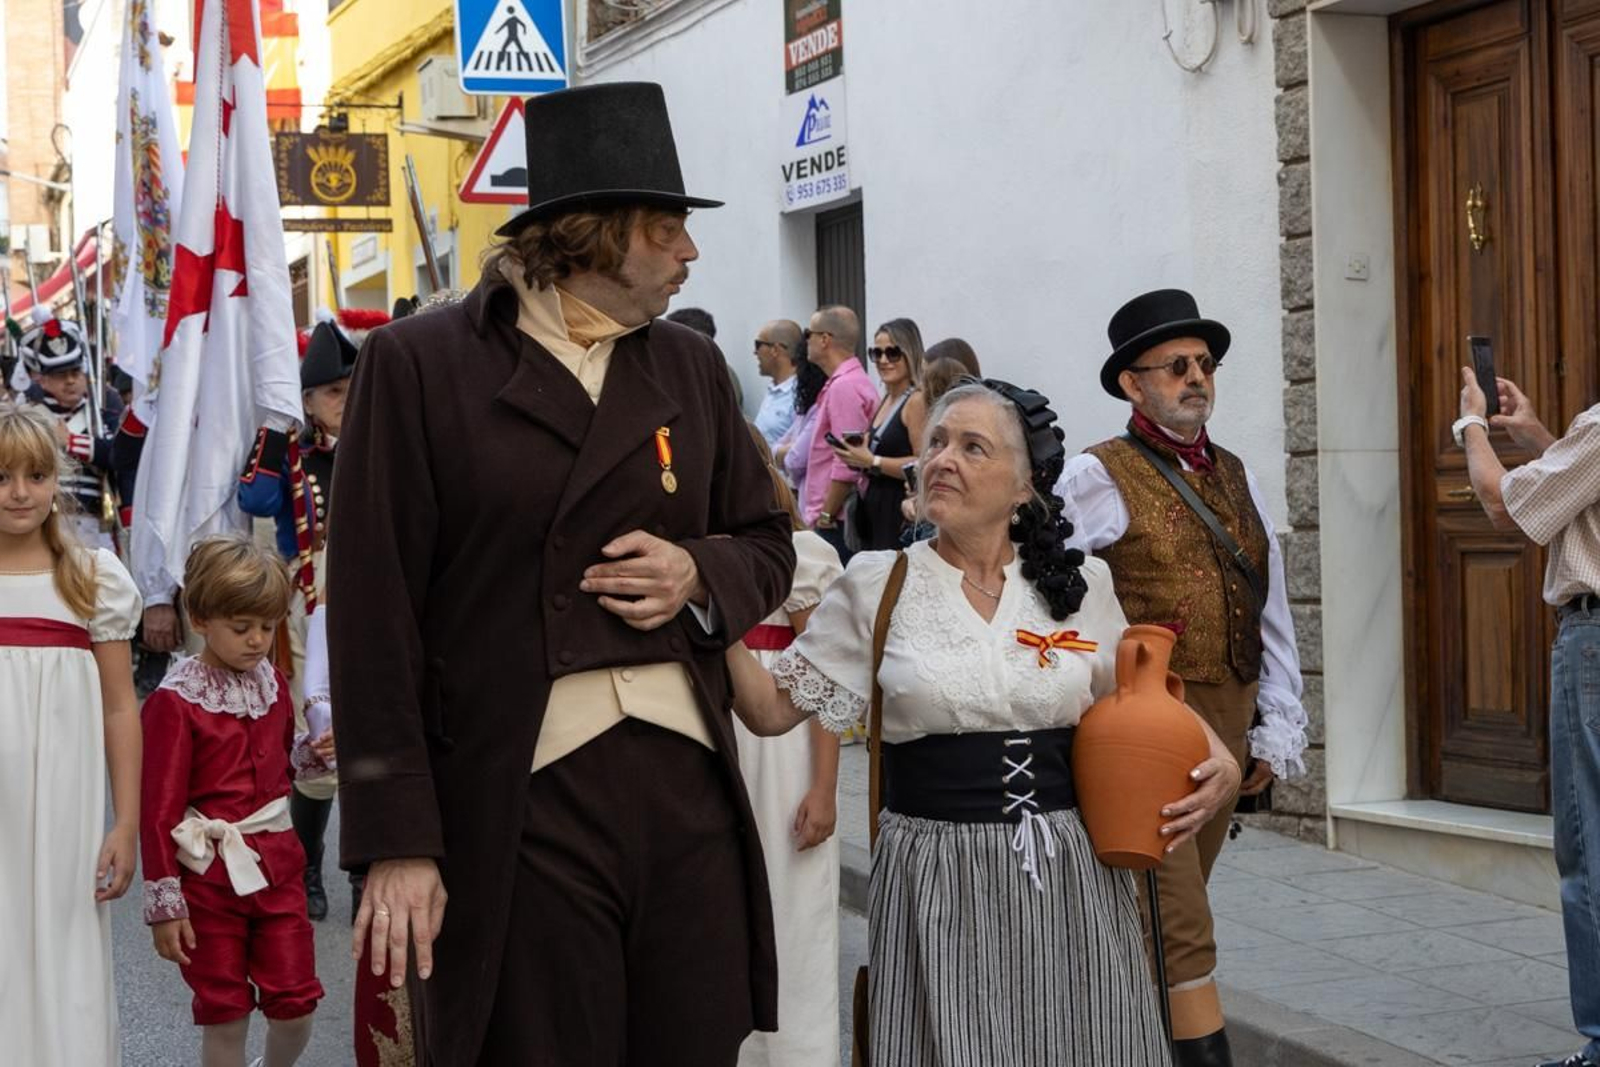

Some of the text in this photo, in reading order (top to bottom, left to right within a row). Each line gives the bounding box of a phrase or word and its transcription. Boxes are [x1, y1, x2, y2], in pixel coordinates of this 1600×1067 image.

[788, 22, 838, 66] VENDE
[781, 145, 846, 183] VENDE
[797, 182, 813, 199] 953
[816, 178, 831, 196] 675
